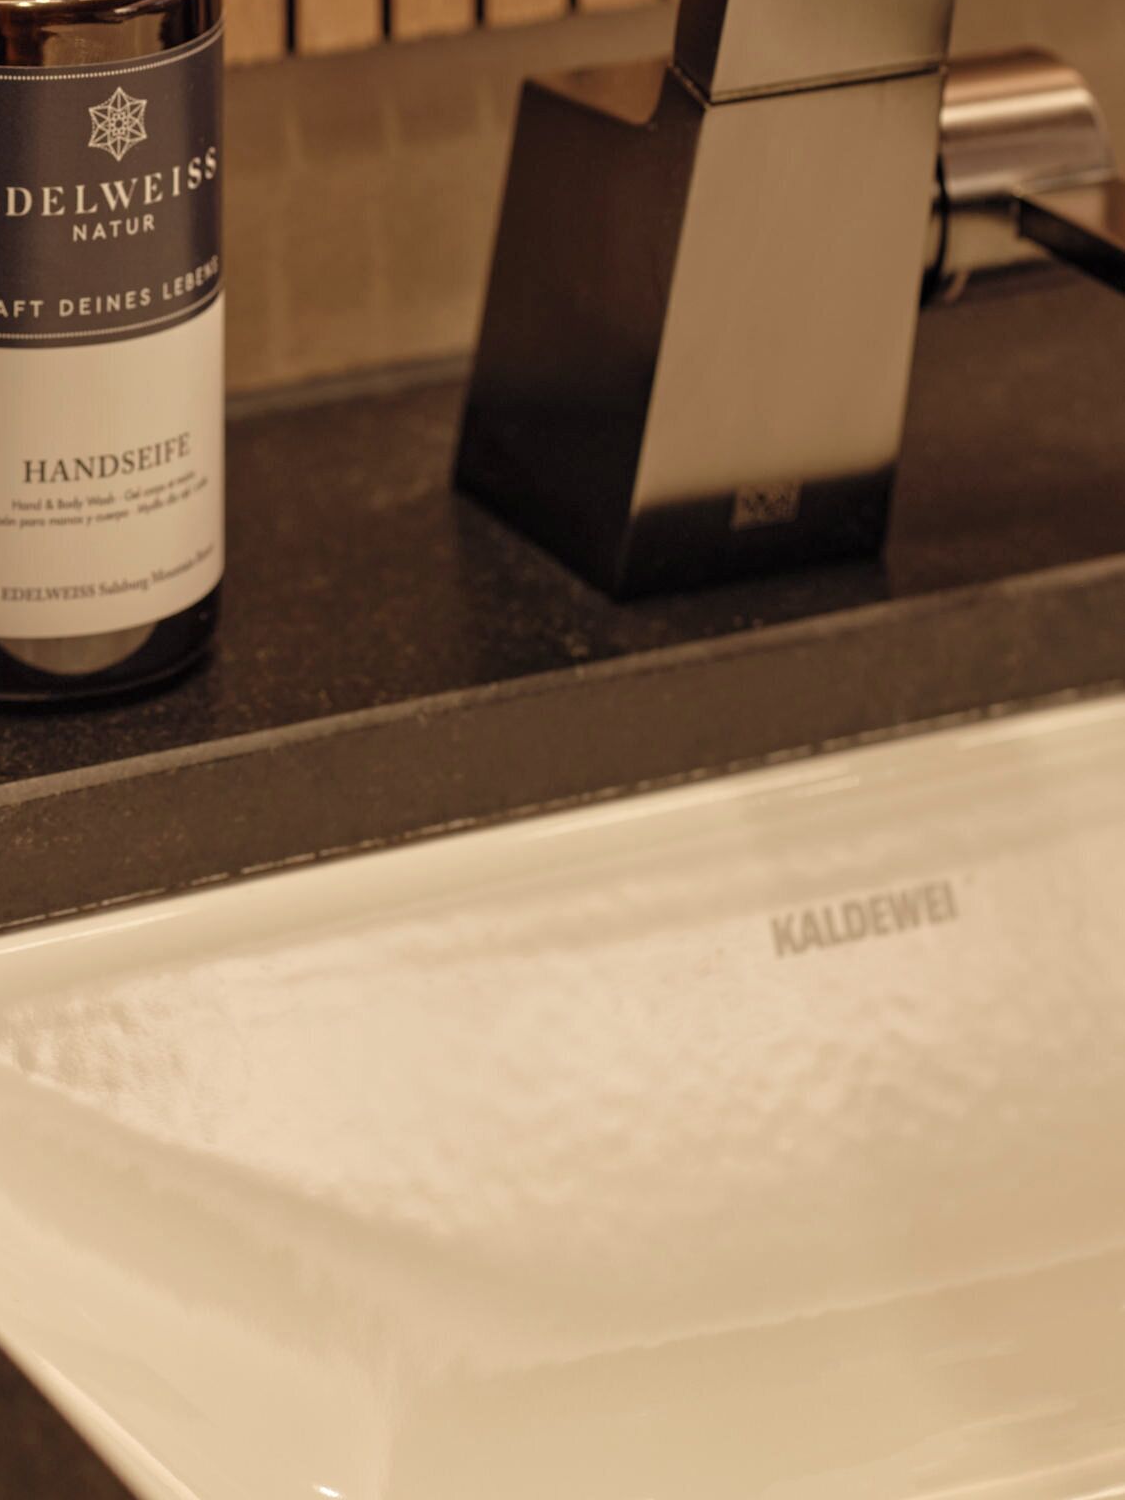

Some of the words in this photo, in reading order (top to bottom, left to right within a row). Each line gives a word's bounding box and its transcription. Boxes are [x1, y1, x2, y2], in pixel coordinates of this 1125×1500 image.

[72, 214, 155, 242] NATUR
[59, 288, 151, 317] DEINES
[23, 431, 191, 484] HANDSEIFE
[1, 583, 96, 602] EDELWEISS
[771, 879, 959, 958] KALDEWEI
